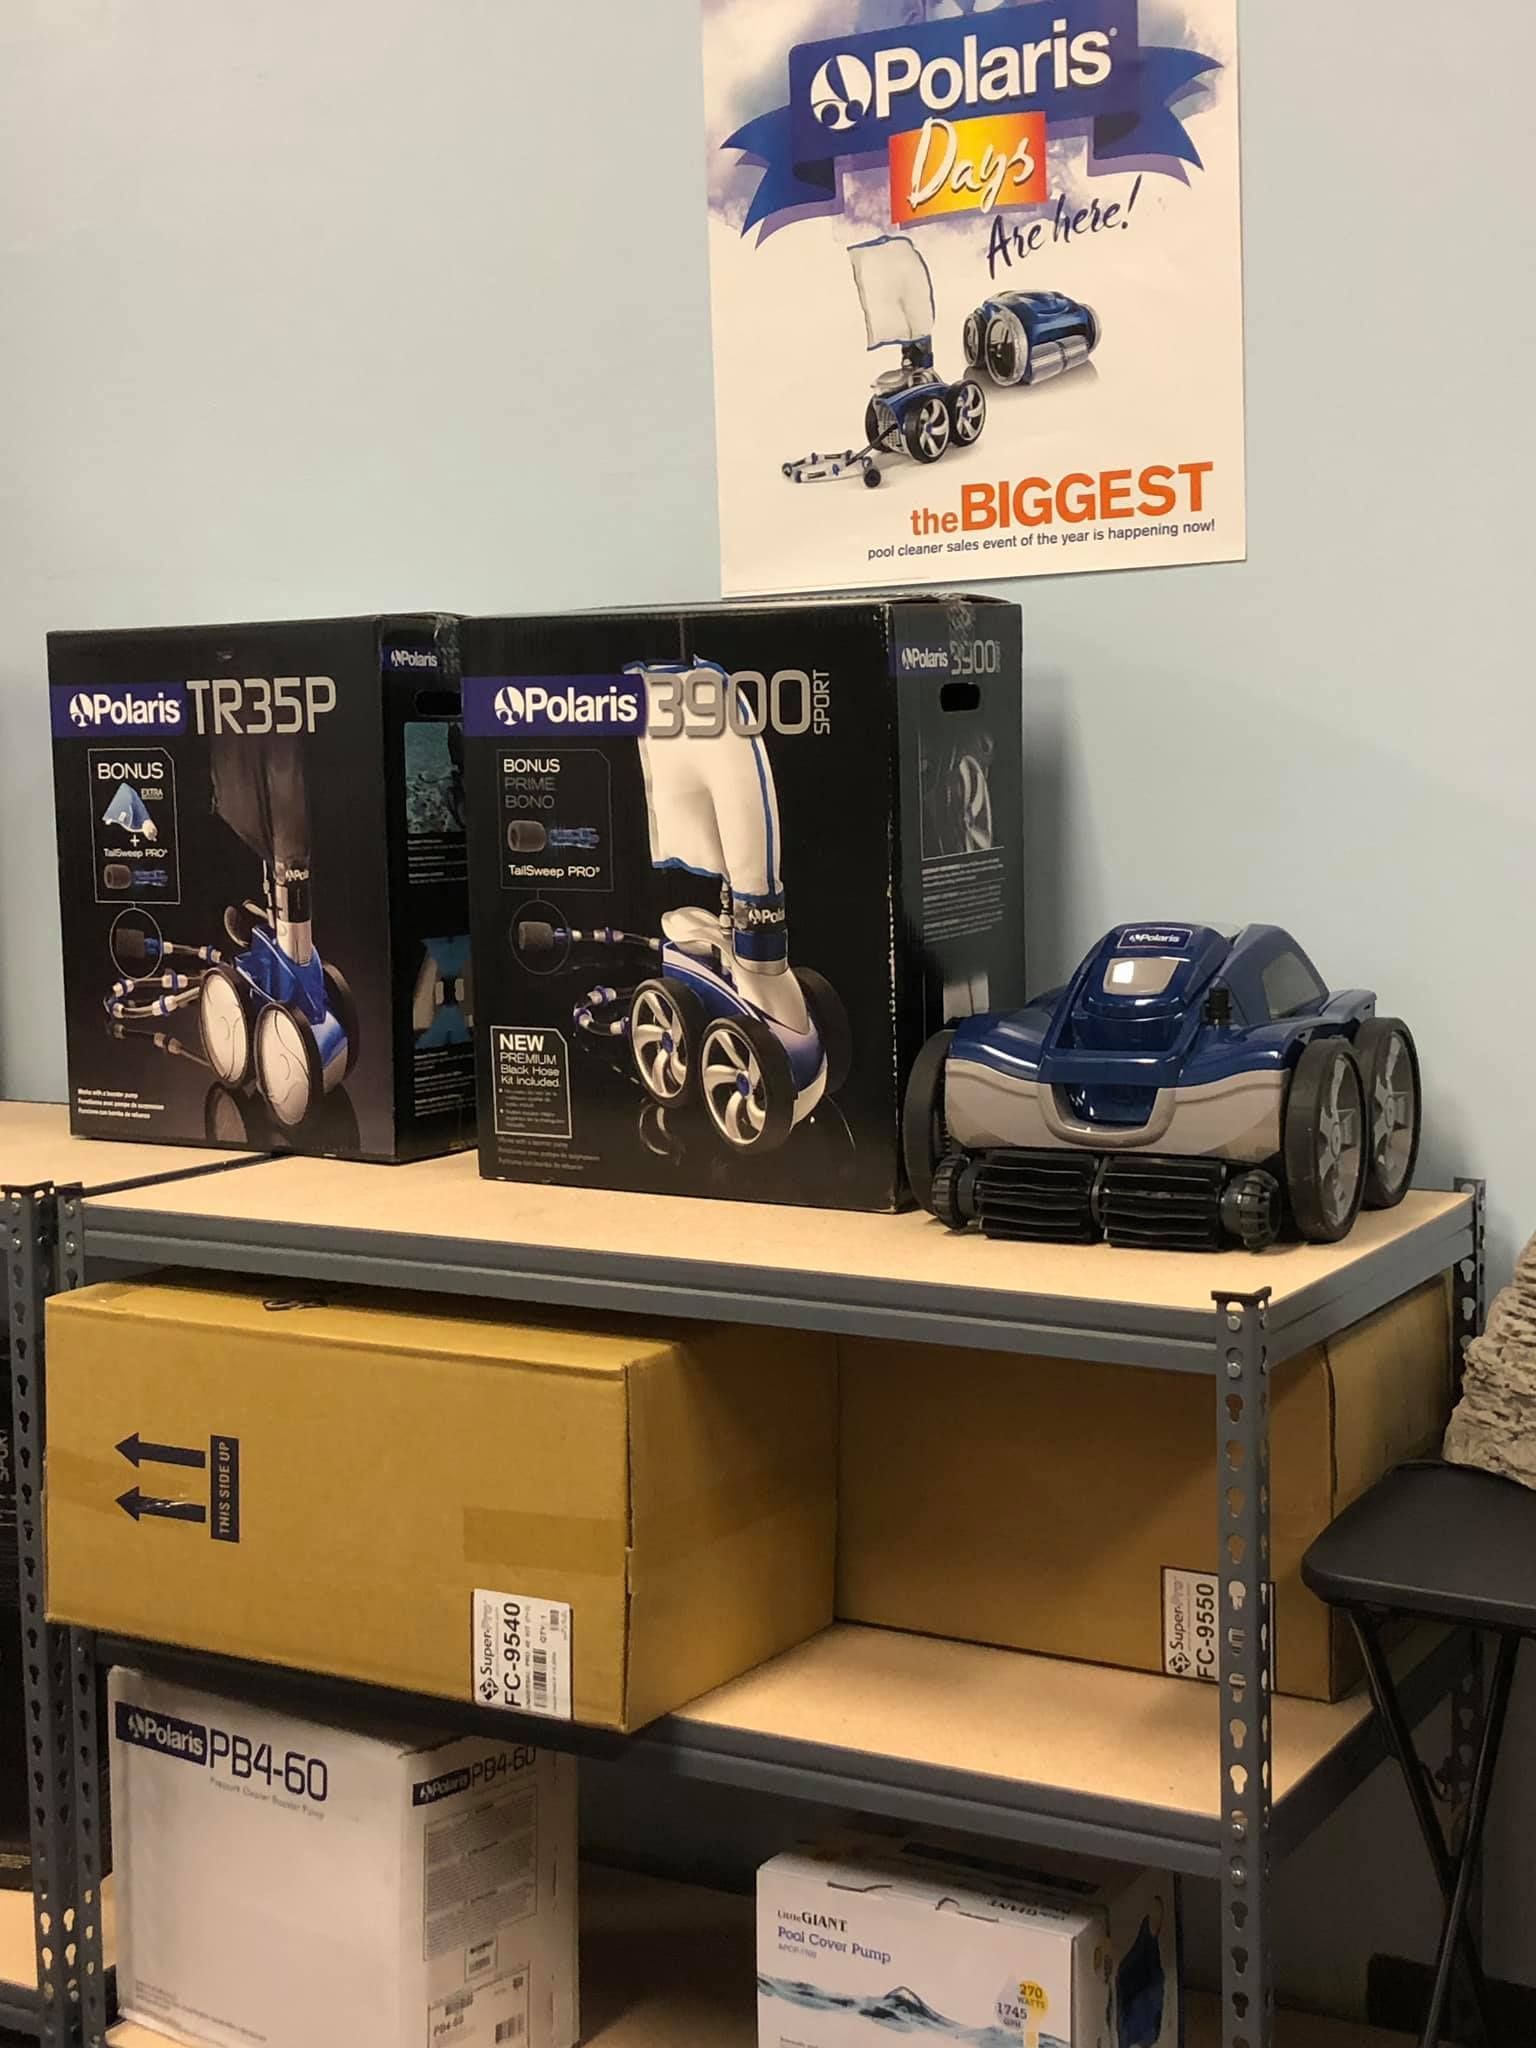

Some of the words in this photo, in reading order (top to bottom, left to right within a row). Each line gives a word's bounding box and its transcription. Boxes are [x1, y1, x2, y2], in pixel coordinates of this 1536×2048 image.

[874, 19, 1111, 118] Polaris
[907, 117, 1035, 212] Days
[987, 215, 1042, 280] Are
[1053, 174, 1142, 244] here!
[868, 545, 894, 560] pool
[897, 543, 943, 556] cleaner
[946, 539, 979, 552] sales
[983, 536, 1016, 548] event
[1020, 534, 1033, 546] of
[1037, 533, 1058, 545] the
[1061, 530, 1090, 546] year
[1093, 528, 1104, 540] is
[1108, 522, 1178, 539] happening
[1183, 518, 1216, 533] now!
[400, 650, 438, 667] Polaris
[912, 648, 948, 668] Polaris
[94, 692, 181, 724] Polaris
[187, 676, 337, 734] TR35P
[525, 684, 637, 724] Polaris
[649, 668, 811, 739] 3900
[813, 669, 831, 735] SPORT
[97, 762, 164, 780] BONUS
[504, 758, 560, 773] BONUS
[505, 777, 556, 791] PRIME
[505, 795, 554, 809] BONO
[508, 865, 564, 878] TailSweep
[1140, 934, 1180, 943] Polaris
[500, 1033, 544, 1051] NEW
[500, 1052, 557, 1065] PREMIUM
[501, 1064, 529, 1075] Black
[532, 1066, 560, 1076] Hose
[501, 1075, 513, 1085] Kit
[219, 1441, 231, 1461] UP
[219, 1465, 231, 1499] SIDE
[219, 1502, 231, 1534] THIS
[1196, 1583, 1215, 1680] FC-9550
[504, 1602, 521, 1707] FC-9540
[144, 1718, 203, 1756] Polaris
[210, 1728, 328, 1801] PB4-60
[778, 1926, 804, 1943] Pool
[809, 1933, 847, 1953] Cover
[852, 1943, 891, 1965] Pump
[1019, 1983, 1043, 1999] 270
[998, 2002, 1027, 2020] 1745
